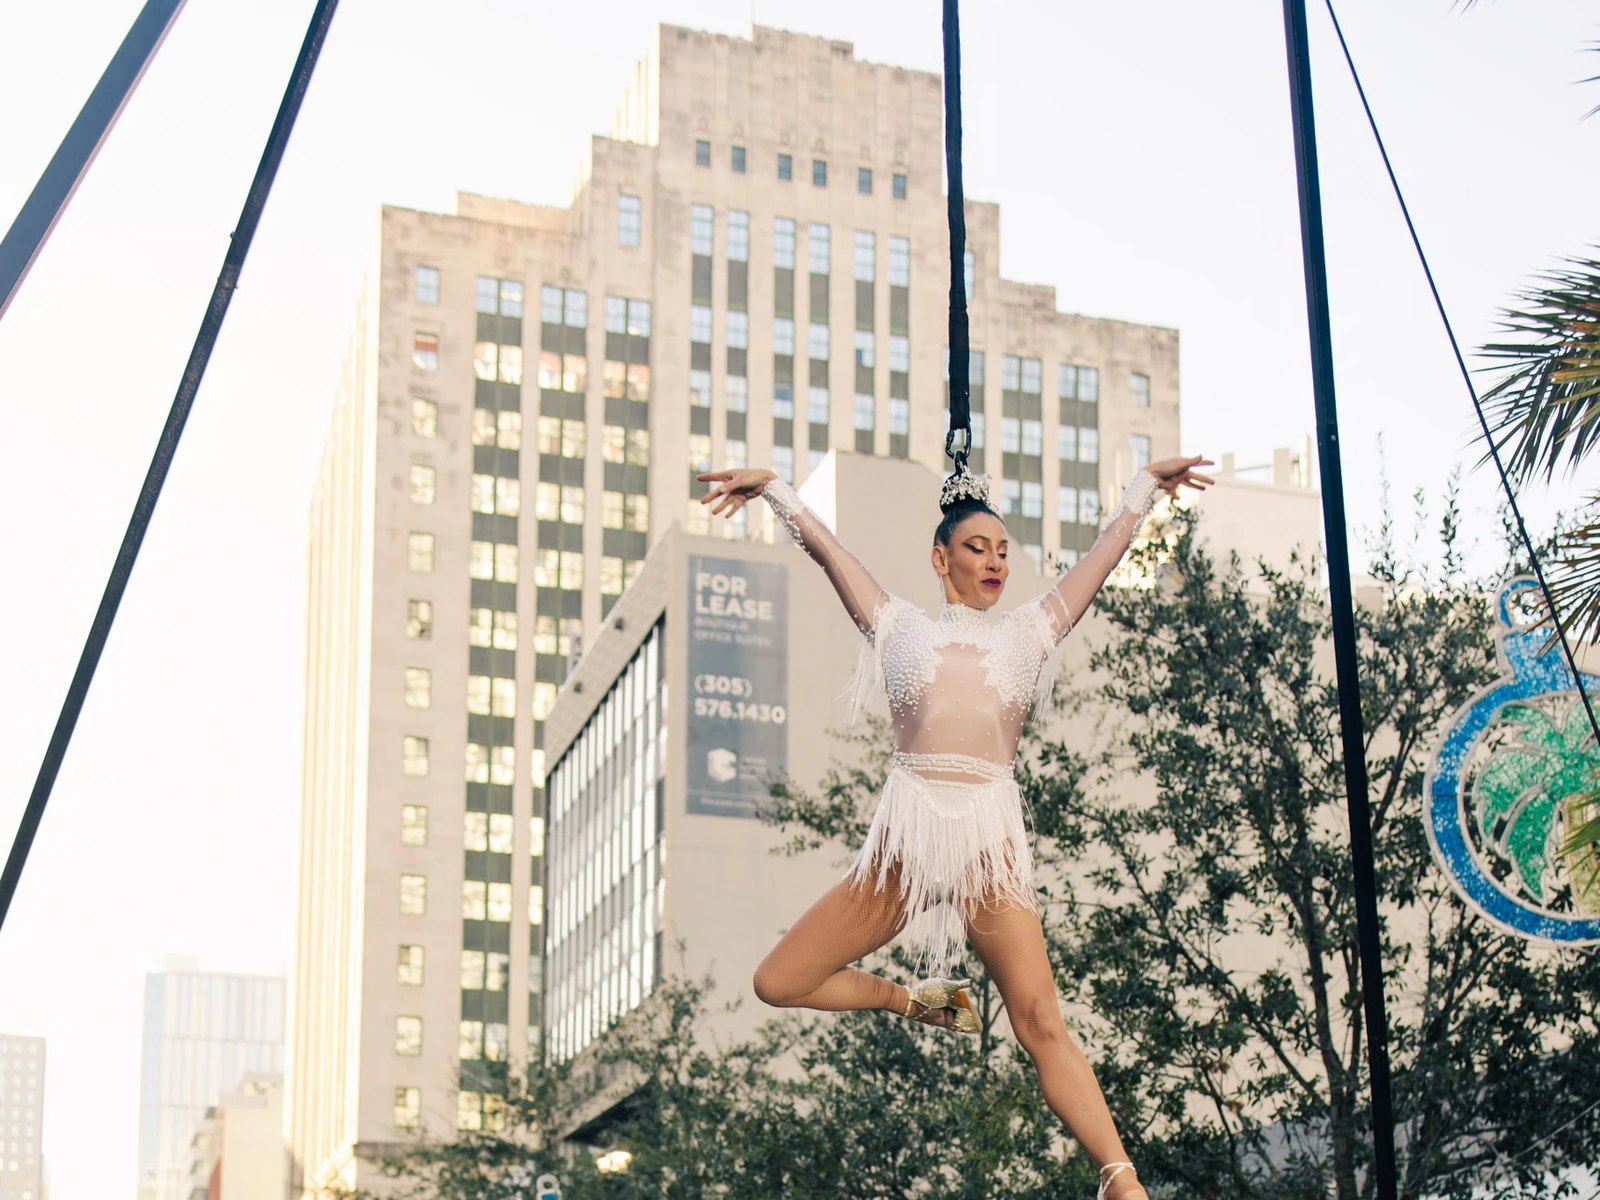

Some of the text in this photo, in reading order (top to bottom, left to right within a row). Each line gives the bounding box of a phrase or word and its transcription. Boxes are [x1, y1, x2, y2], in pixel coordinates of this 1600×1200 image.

[695, 573, 747, 597] FOR
[695, 593, 773, 621] LEASE
[694, 674, 752, 698] (305)
[694, 698, 785, 724] 576.1430
